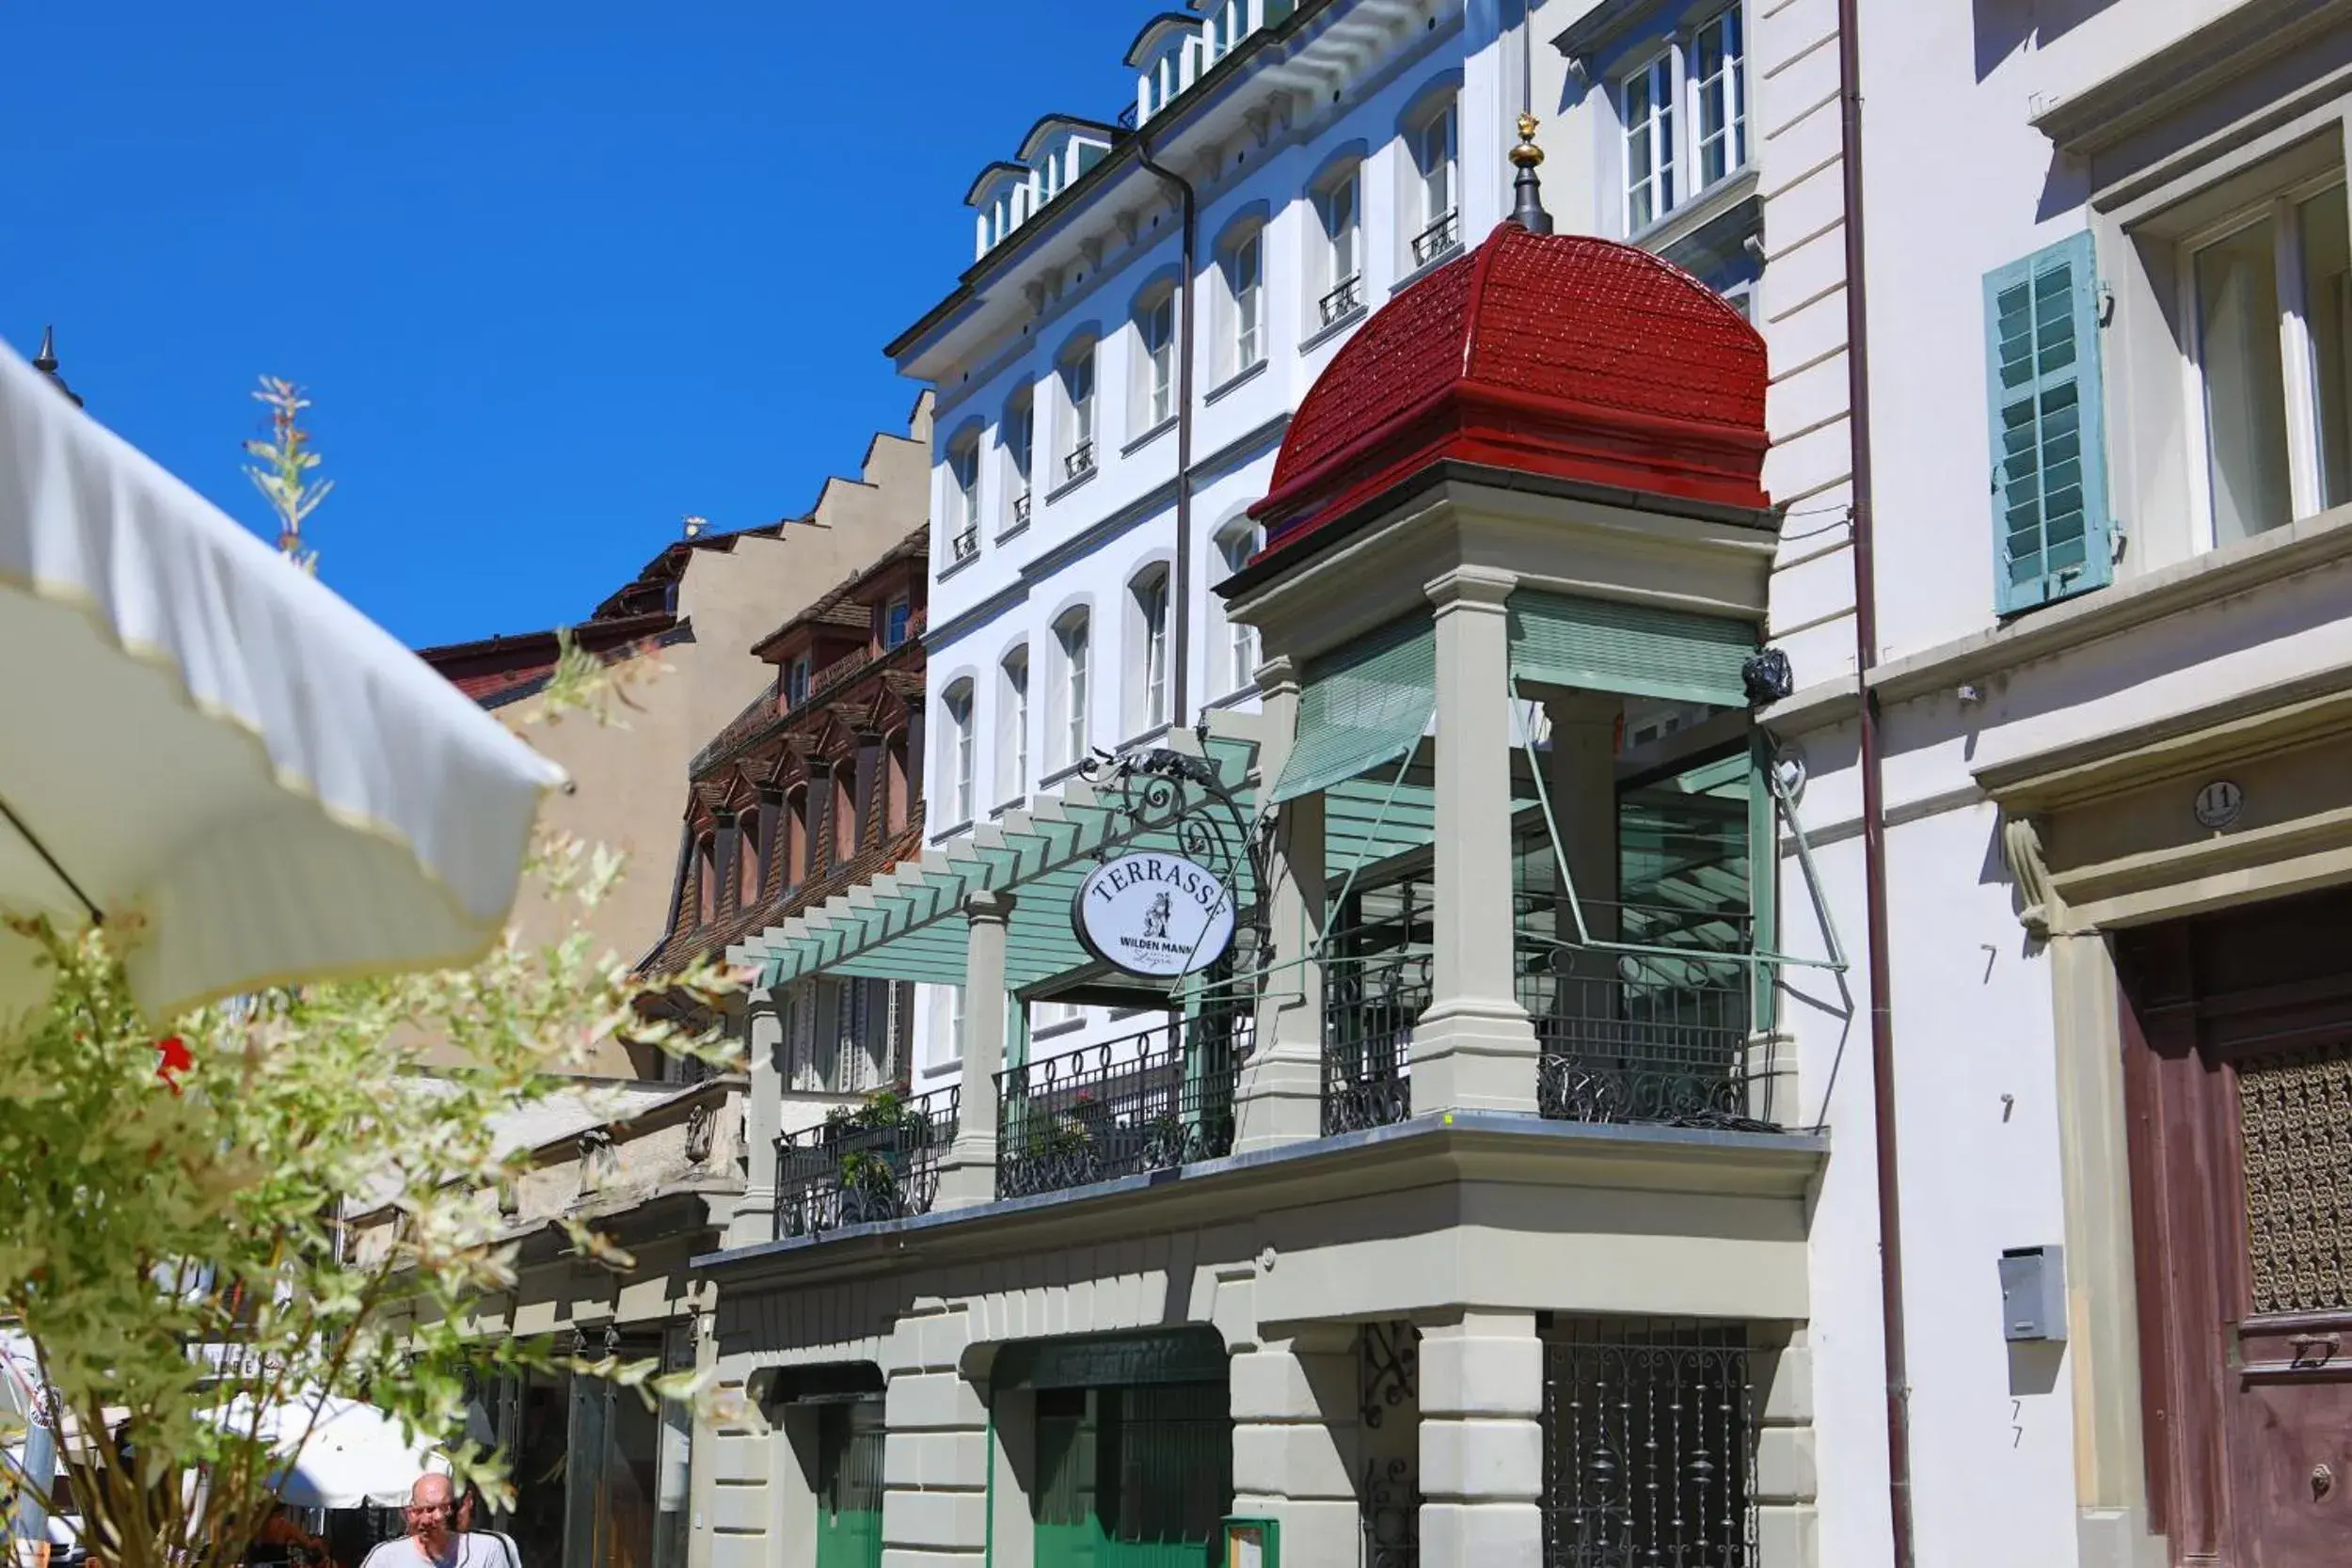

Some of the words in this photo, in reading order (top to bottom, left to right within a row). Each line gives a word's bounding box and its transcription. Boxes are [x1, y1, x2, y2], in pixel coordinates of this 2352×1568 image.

[2206, 784, 2231, 812] 11
[1092, 860, 1226, 920] TERRASSE
[1120, 936, 1160, 951] WILDEN
[1161, 942, 1193, 954] MANN
